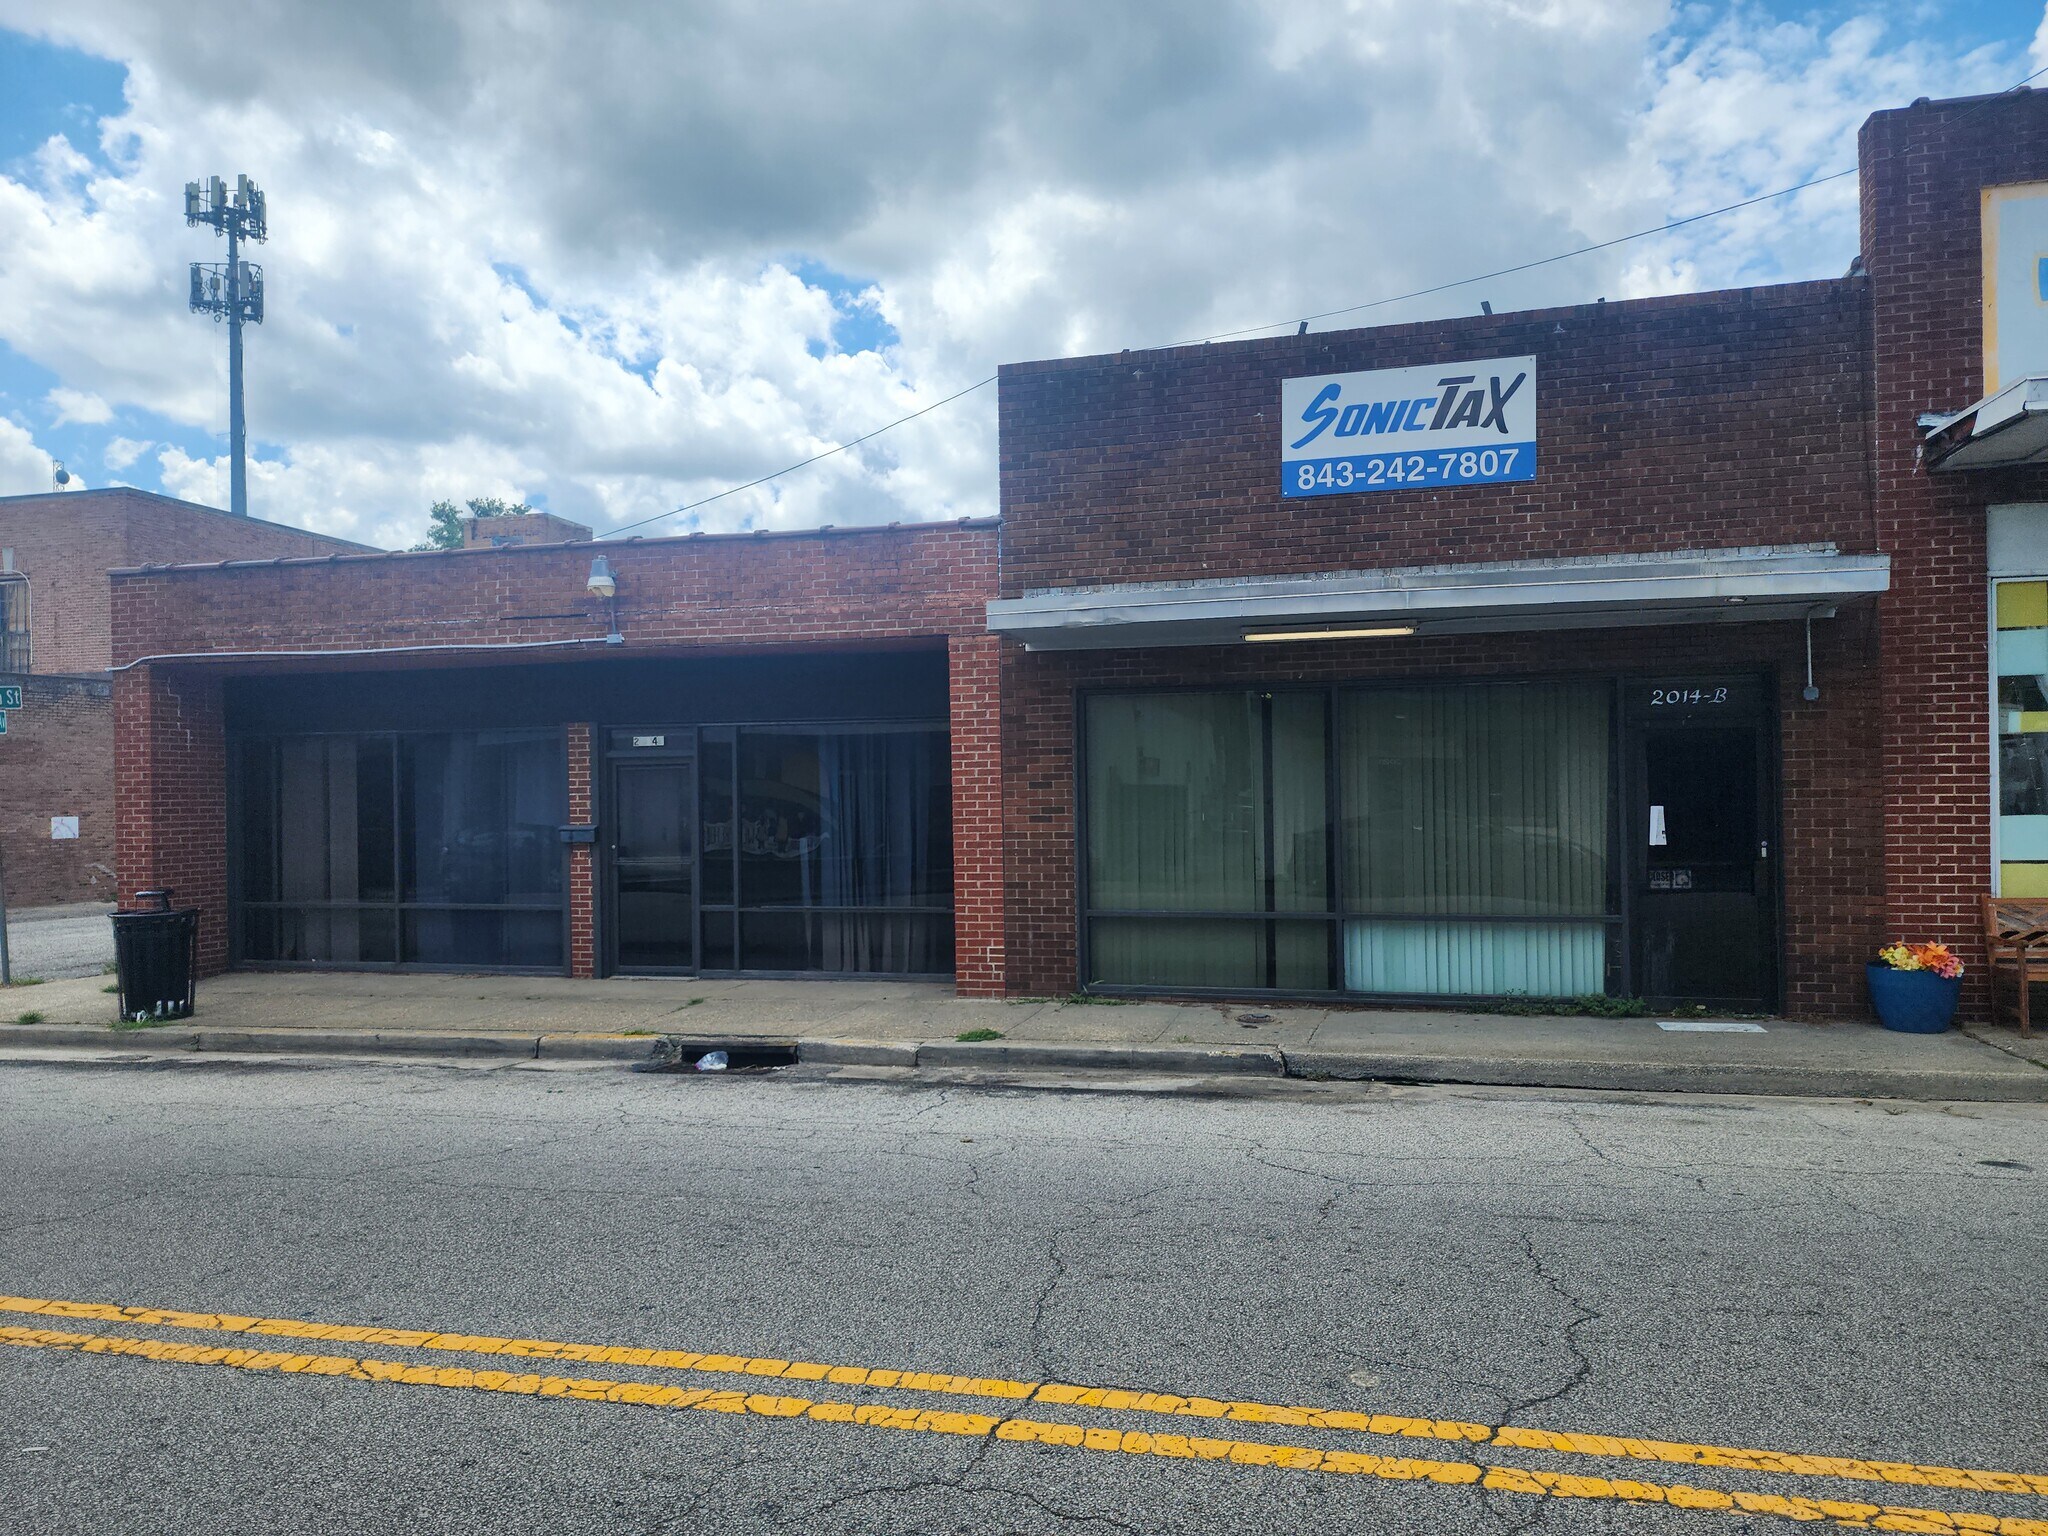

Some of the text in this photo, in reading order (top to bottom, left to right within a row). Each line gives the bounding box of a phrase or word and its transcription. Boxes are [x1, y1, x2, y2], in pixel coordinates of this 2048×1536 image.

[1297, 448, 1519, 490] 843-242-7807
[6, 689, 19, 705] St
[1650, 687, 1727, 706] 2014-B
